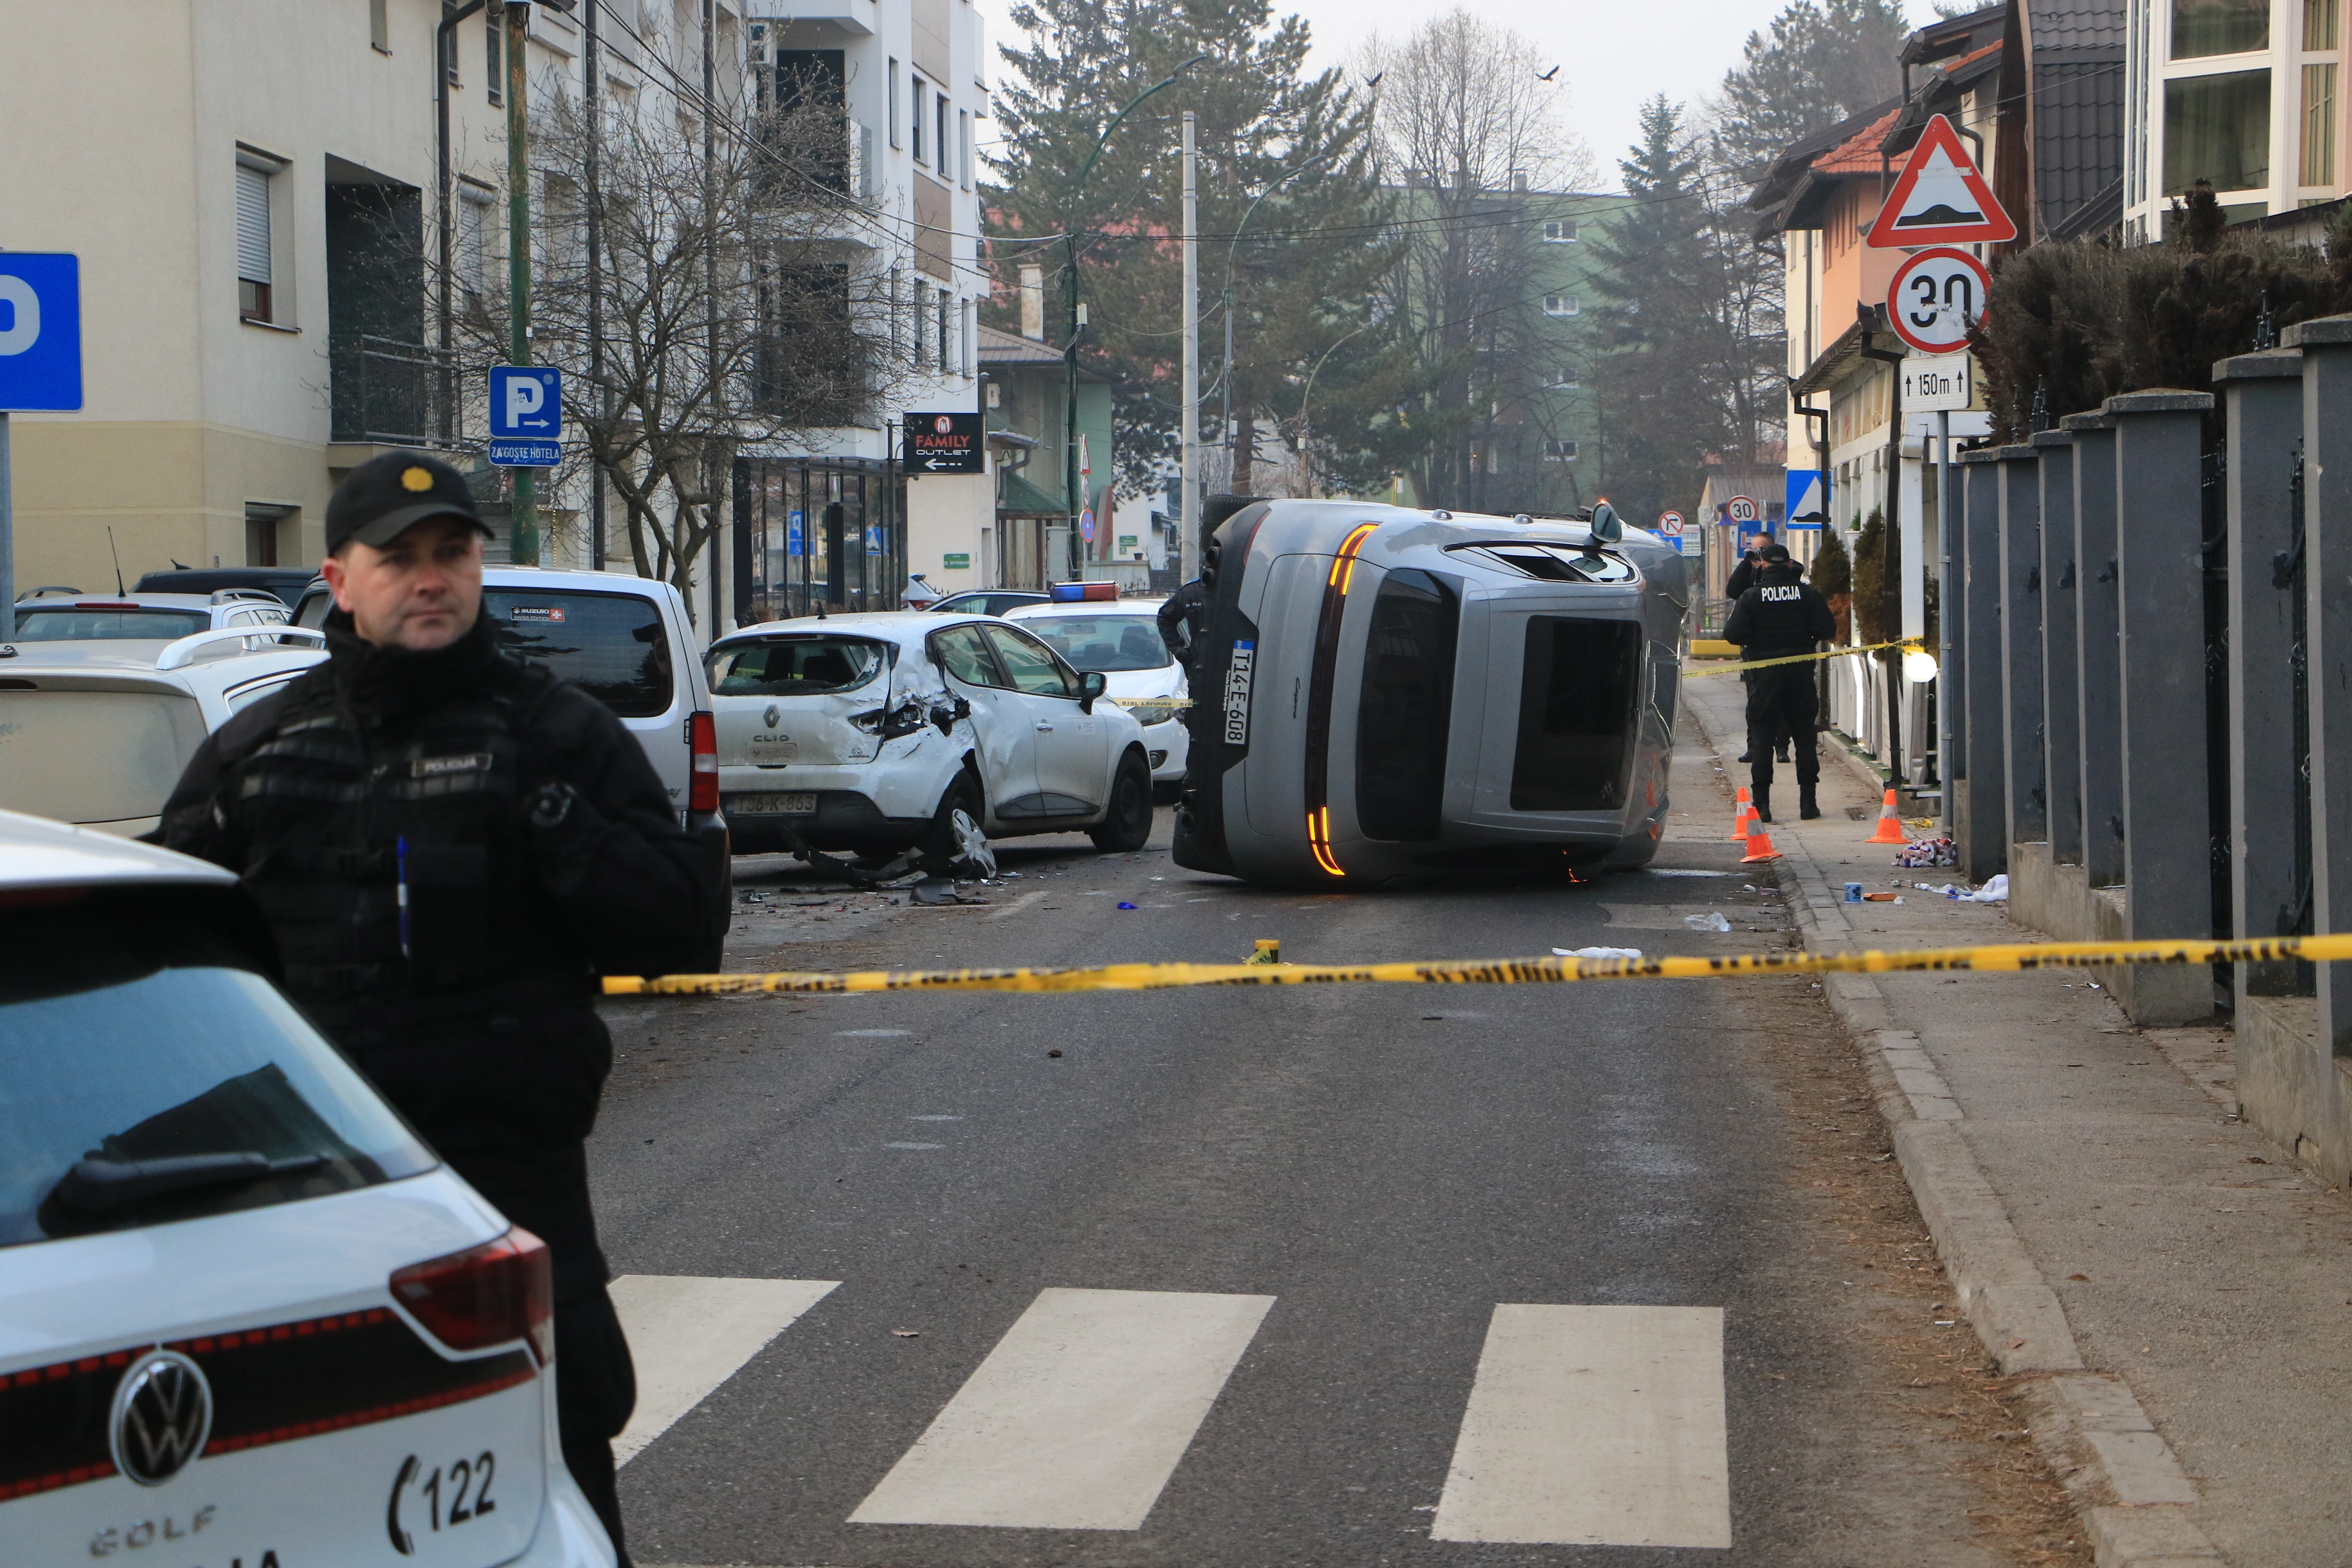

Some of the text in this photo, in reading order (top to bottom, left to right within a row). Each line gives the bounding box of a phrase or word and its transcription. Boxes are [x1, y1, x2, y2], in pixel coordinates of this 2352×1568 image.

[1919, 374, 1949, 395] 150 m
[506, 376, 544, 428] P
[916, 435, 970, 447] FAMILY
[530, 448, 560, 459] HOTELA
[1733, 503, 1752, 518] 30
[1761, 585, 1801, 602] POLICIJA
[1228, 653, 1251, 741] T14-E-608
[423, 1450, 496, 1532] 122
[90, 1504, 215, 1557] GOLF
